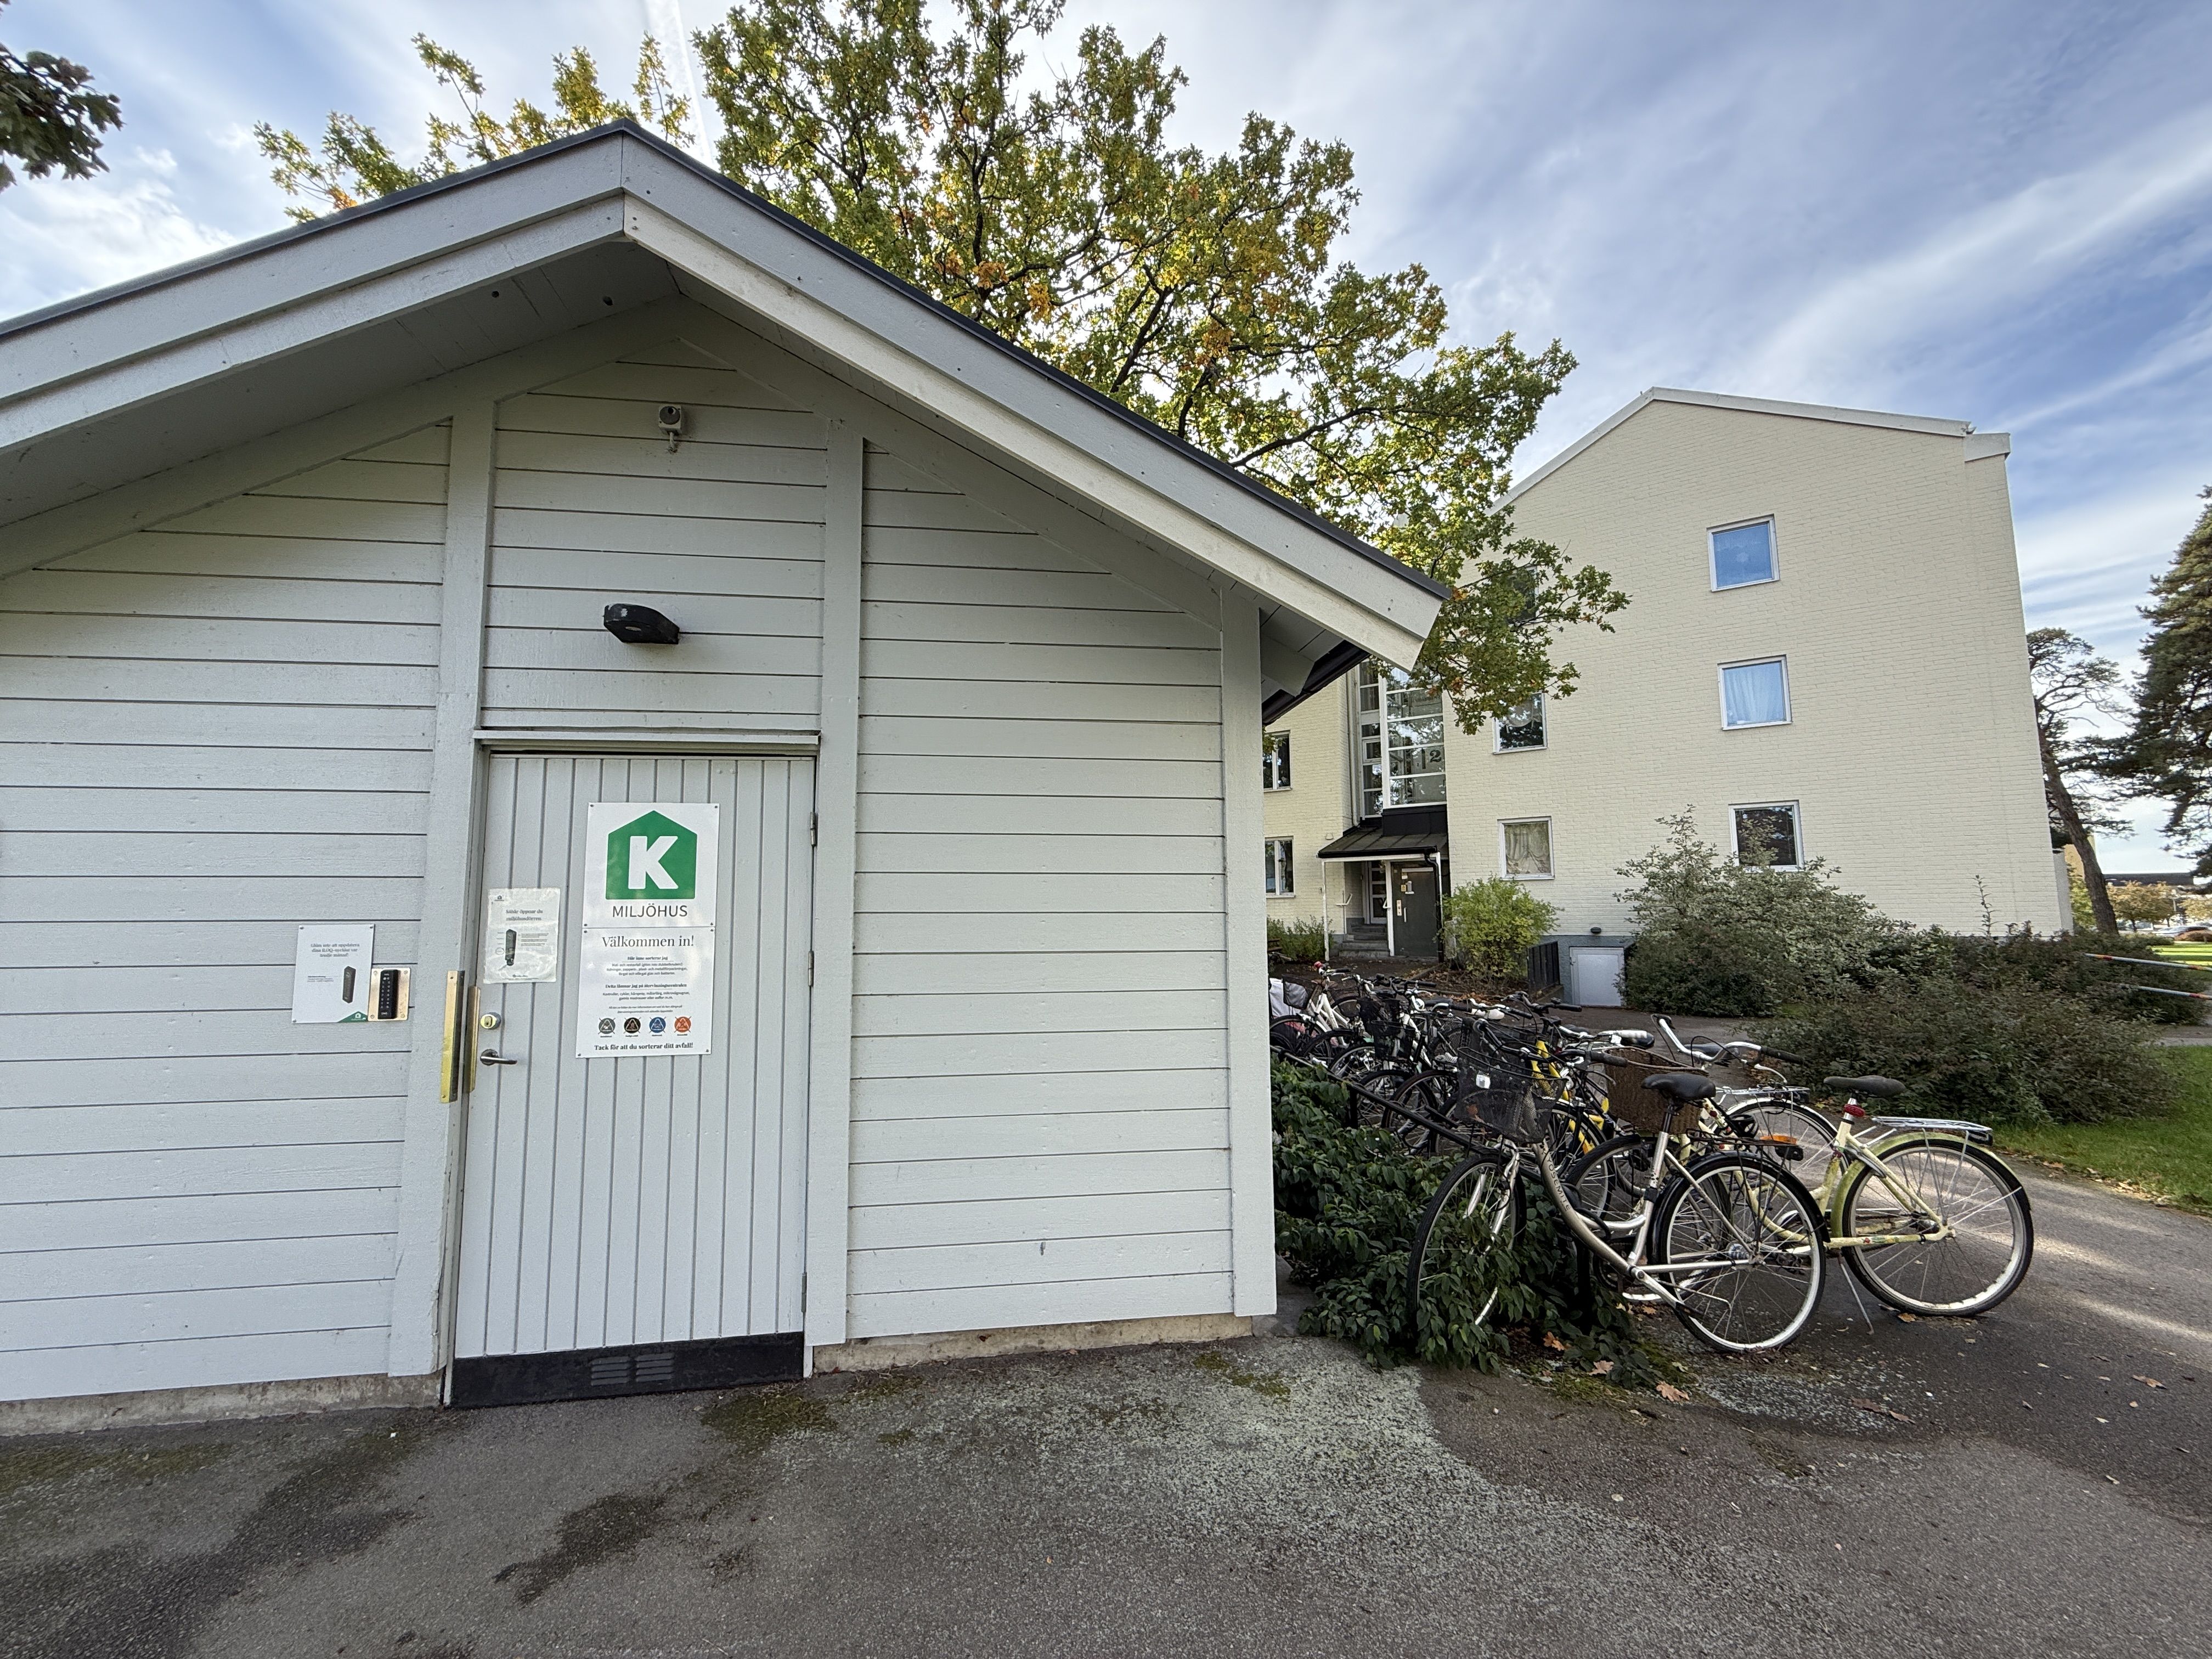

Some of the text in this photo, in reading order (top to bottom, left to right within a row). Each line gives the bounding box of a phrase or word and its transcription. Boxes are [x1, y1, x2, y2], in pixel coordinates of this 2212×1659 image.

[1430, 749, 1442, 763] 2
[628, 836, 679, 889] K
[1405, 881, 1414, 894] 1
[612, 903, 688, 917] MILJÖHUS
[602, 935, 694, 947] Välkommen in!
[1547, 1156, 1571, 1212] YOSEMITE
